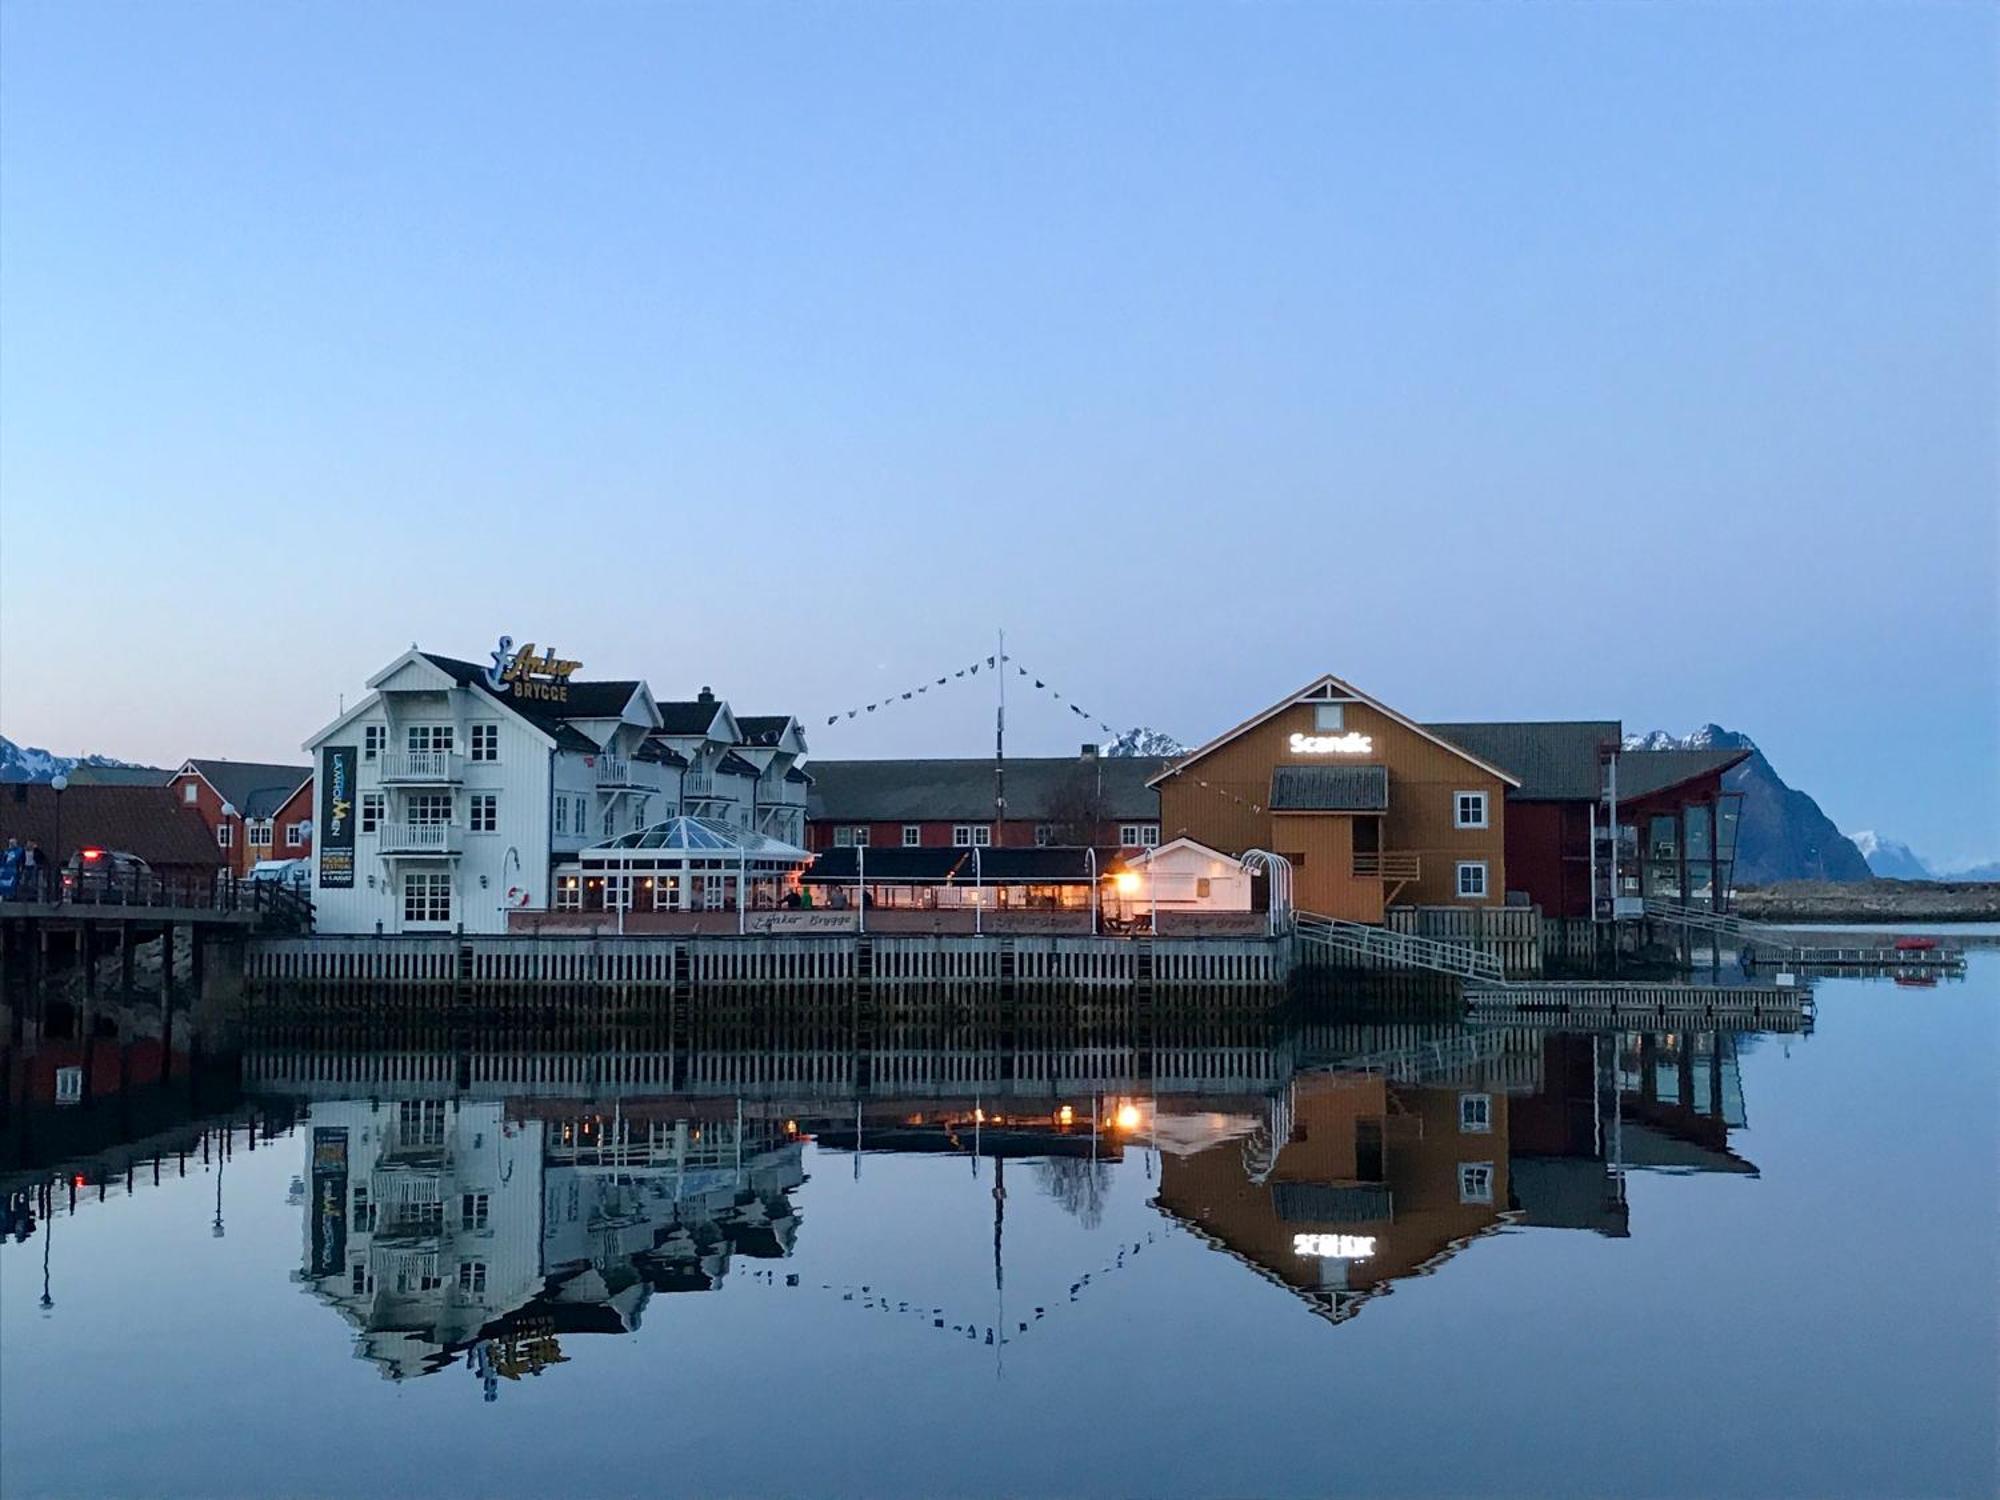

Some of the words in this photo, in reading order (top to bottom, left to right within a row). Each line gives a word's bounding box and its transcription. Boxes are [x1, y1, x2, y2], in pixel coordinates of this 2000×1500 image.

[503, 643, 584, 681] Anker
[513, 681, 569, 703] BRYGGE
[1289, 732, 1373, 753] Scandic
